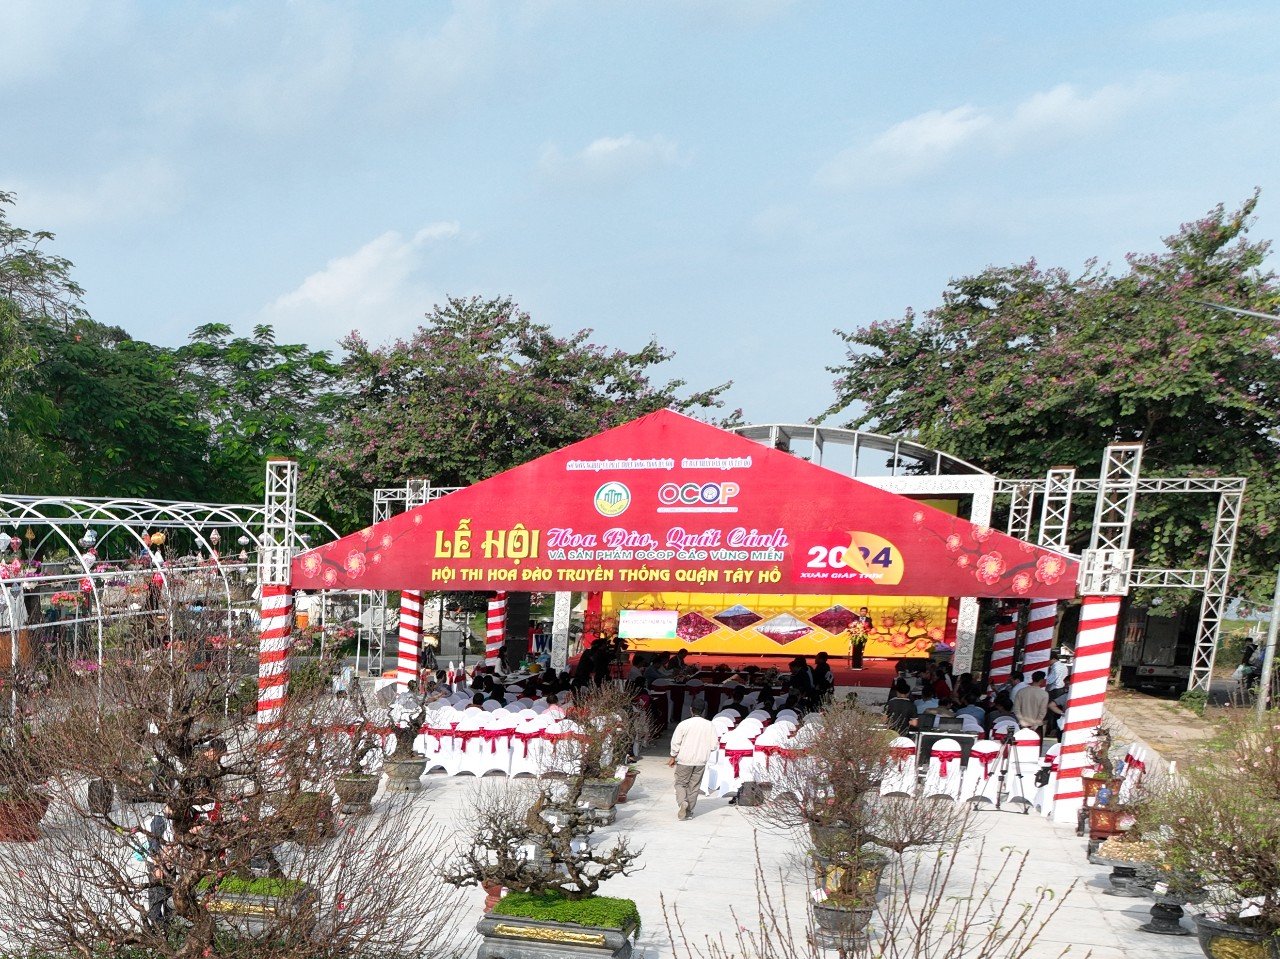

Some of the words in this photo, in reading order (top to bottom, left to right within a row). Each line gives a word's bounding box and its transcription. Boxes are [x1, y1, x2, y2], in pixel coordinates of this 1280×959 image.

[658, 482, 740, 505] OCOP
[435, 518, 472, 559] LỄ
[481, 523, 541, 565] HỘI
[547, 528, 597, 547] Hoa
[548, 547, 565, 560] VÀ
[568, 547, 593, 560] SẢN
[635, 549, 675, 561] OCOP
[677, 547, 708, 561] CÁC
[710, 547, 749, 561] VÙNG
[432, 566, 456, 583] HỘI
[460, 568, 483, 581] THI
[488, 568, 518, 582] HOA
[522, 566, 553, 582] ĐÀO
[557, 564, 614, 582] TRUYỀN
[619, 564, 671, 583] THỐNG
[675, 567, 719, 585] QUẬN
[723, 567, 754, 583] TÂY
[758, 565, 782, 584] HỒ
